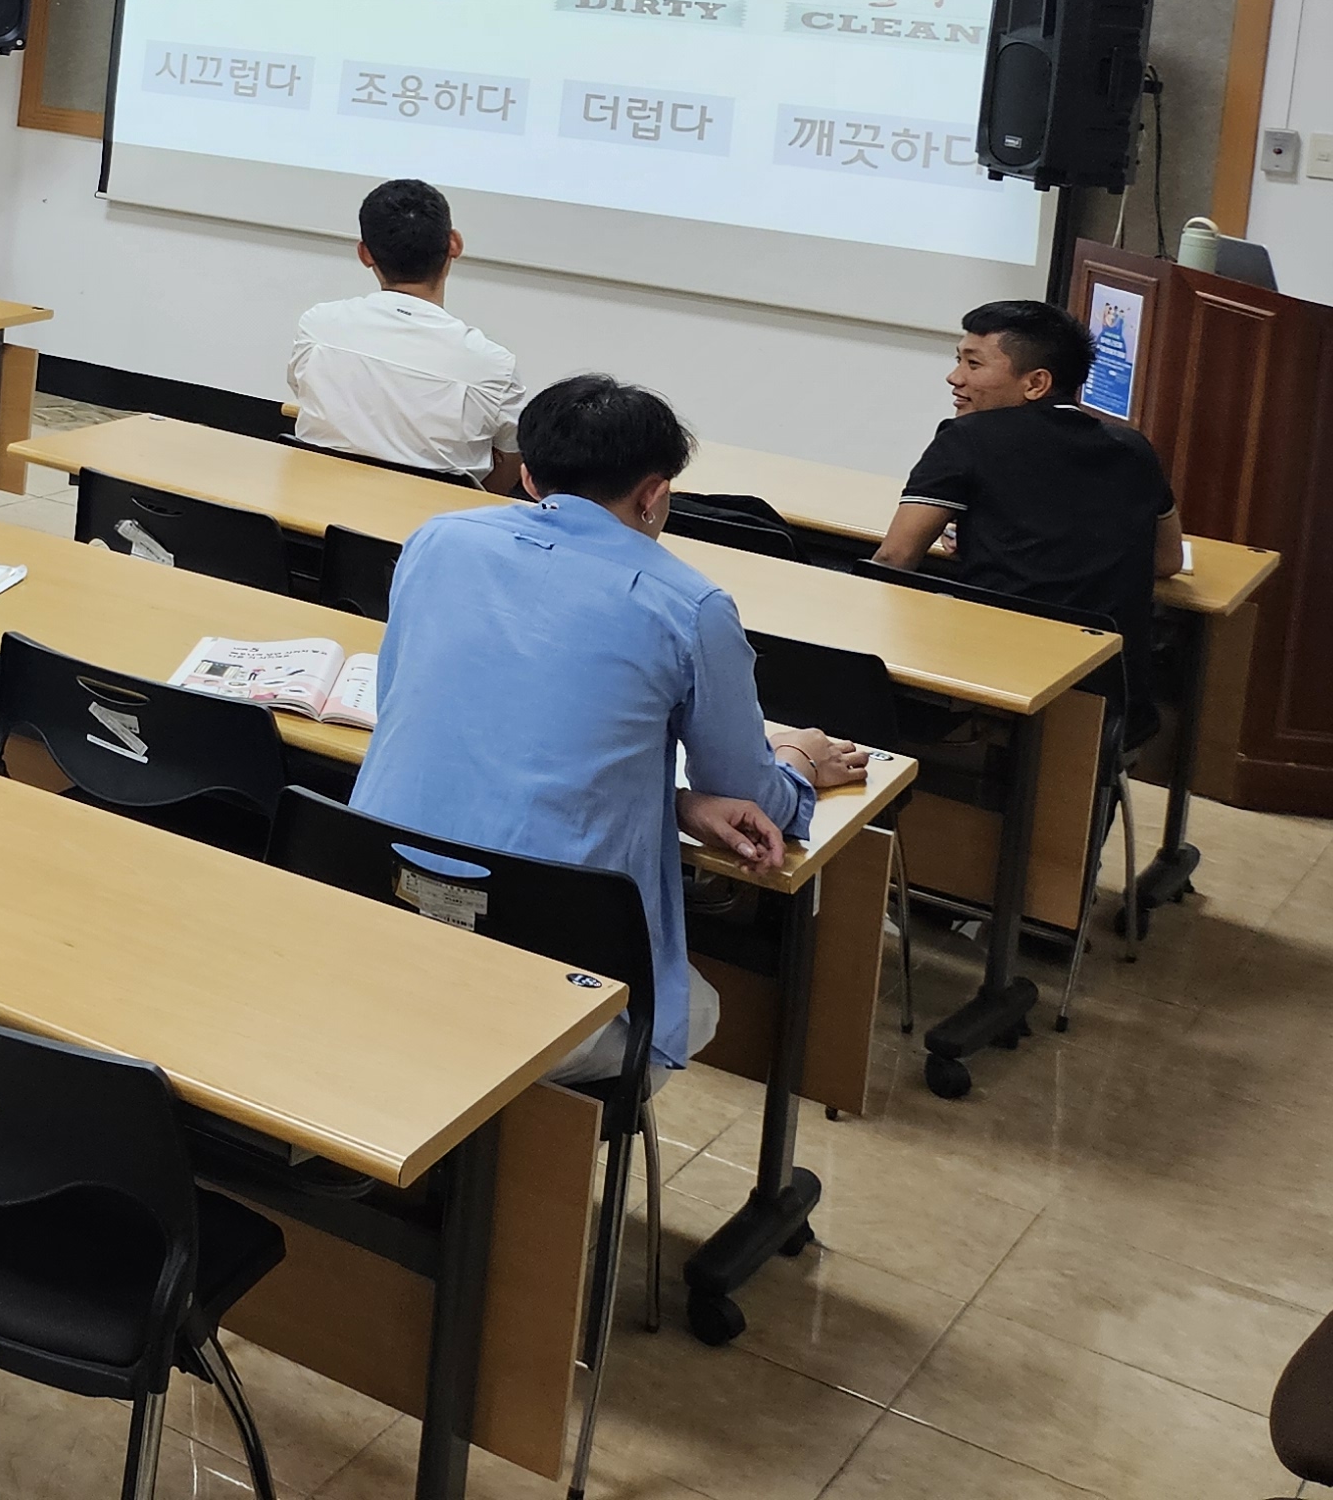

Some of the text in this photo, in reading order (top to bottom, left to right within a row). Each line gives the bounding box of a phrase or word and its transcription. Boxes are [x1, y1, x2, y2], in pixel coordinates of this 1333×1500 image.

[800, 11, 984, 45] CLEAN
[155, 52, 301, 98] 시끄럽다
[351, 71, 516, 121] 조용하다
[582, 93, 713, 142] 더럽다
